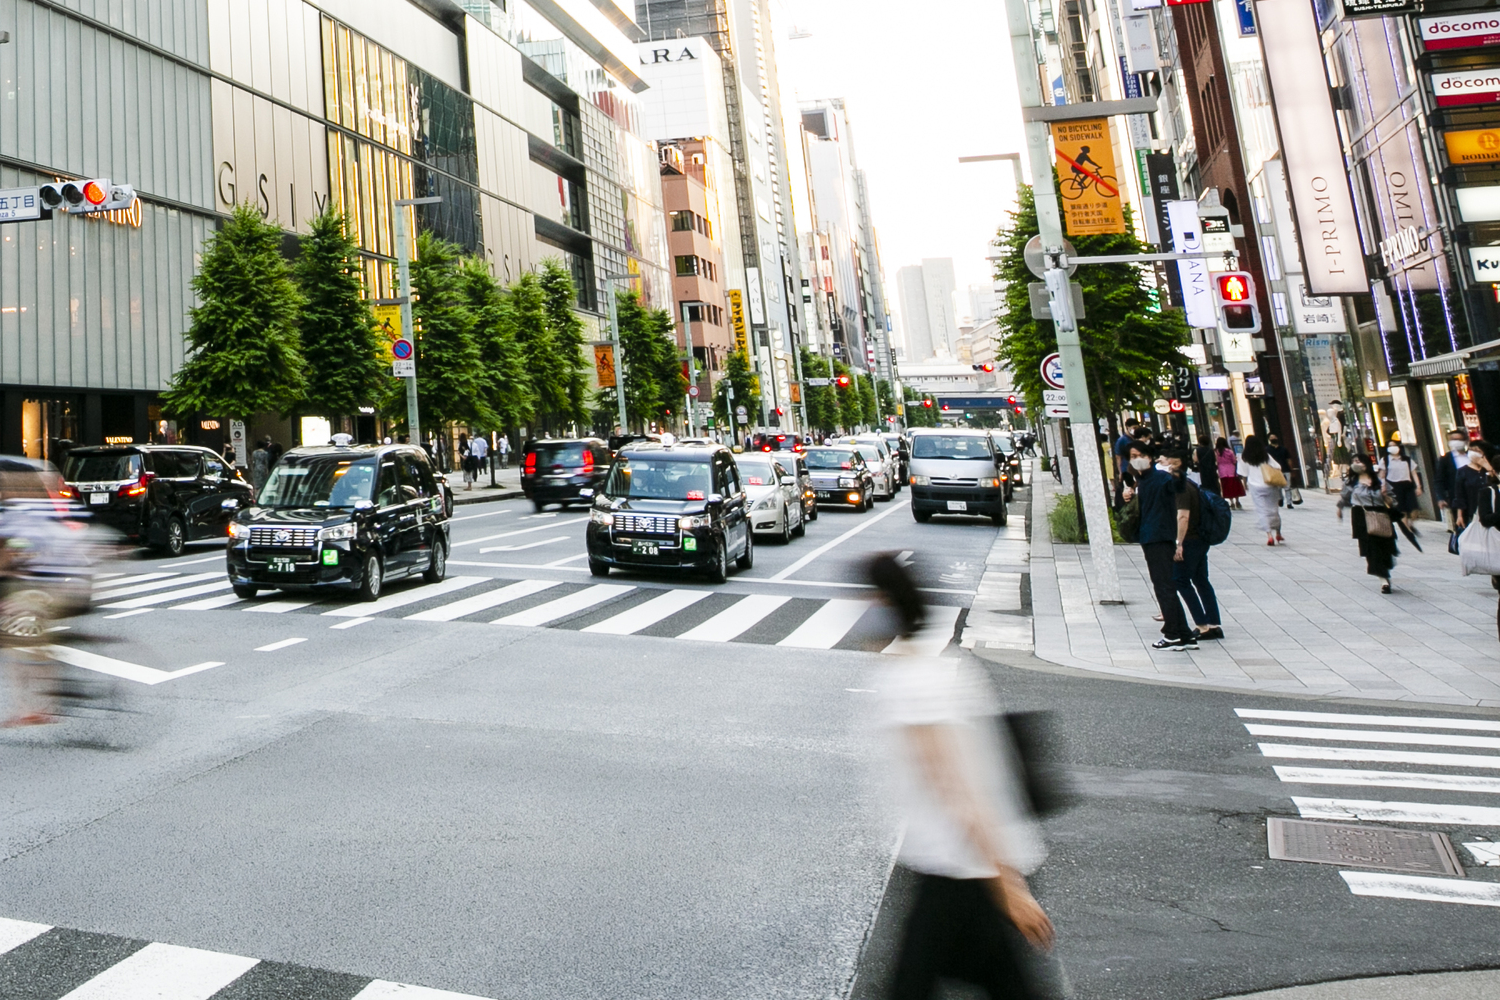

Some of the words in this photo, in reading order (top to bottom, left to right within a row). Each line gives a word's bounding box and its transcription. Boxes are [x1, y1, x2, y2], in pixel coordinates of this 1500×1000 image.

[1428, 19, 1500, 34] docomo
[1068, 123, 1103, 133] BICYCLING
[1069, 132, 1104, 141] SIDEWALK
[1461, 153, 1500, 161] Roma
[11, 209, 16, 218] 5
[1311, 176, 1345, 275] I-PRIMO
[1379, 225, 1419, 268] I-PRIMO
[1183, 231, 1205, 296] DANA
[1477, 259, 1499, 271] Ku
